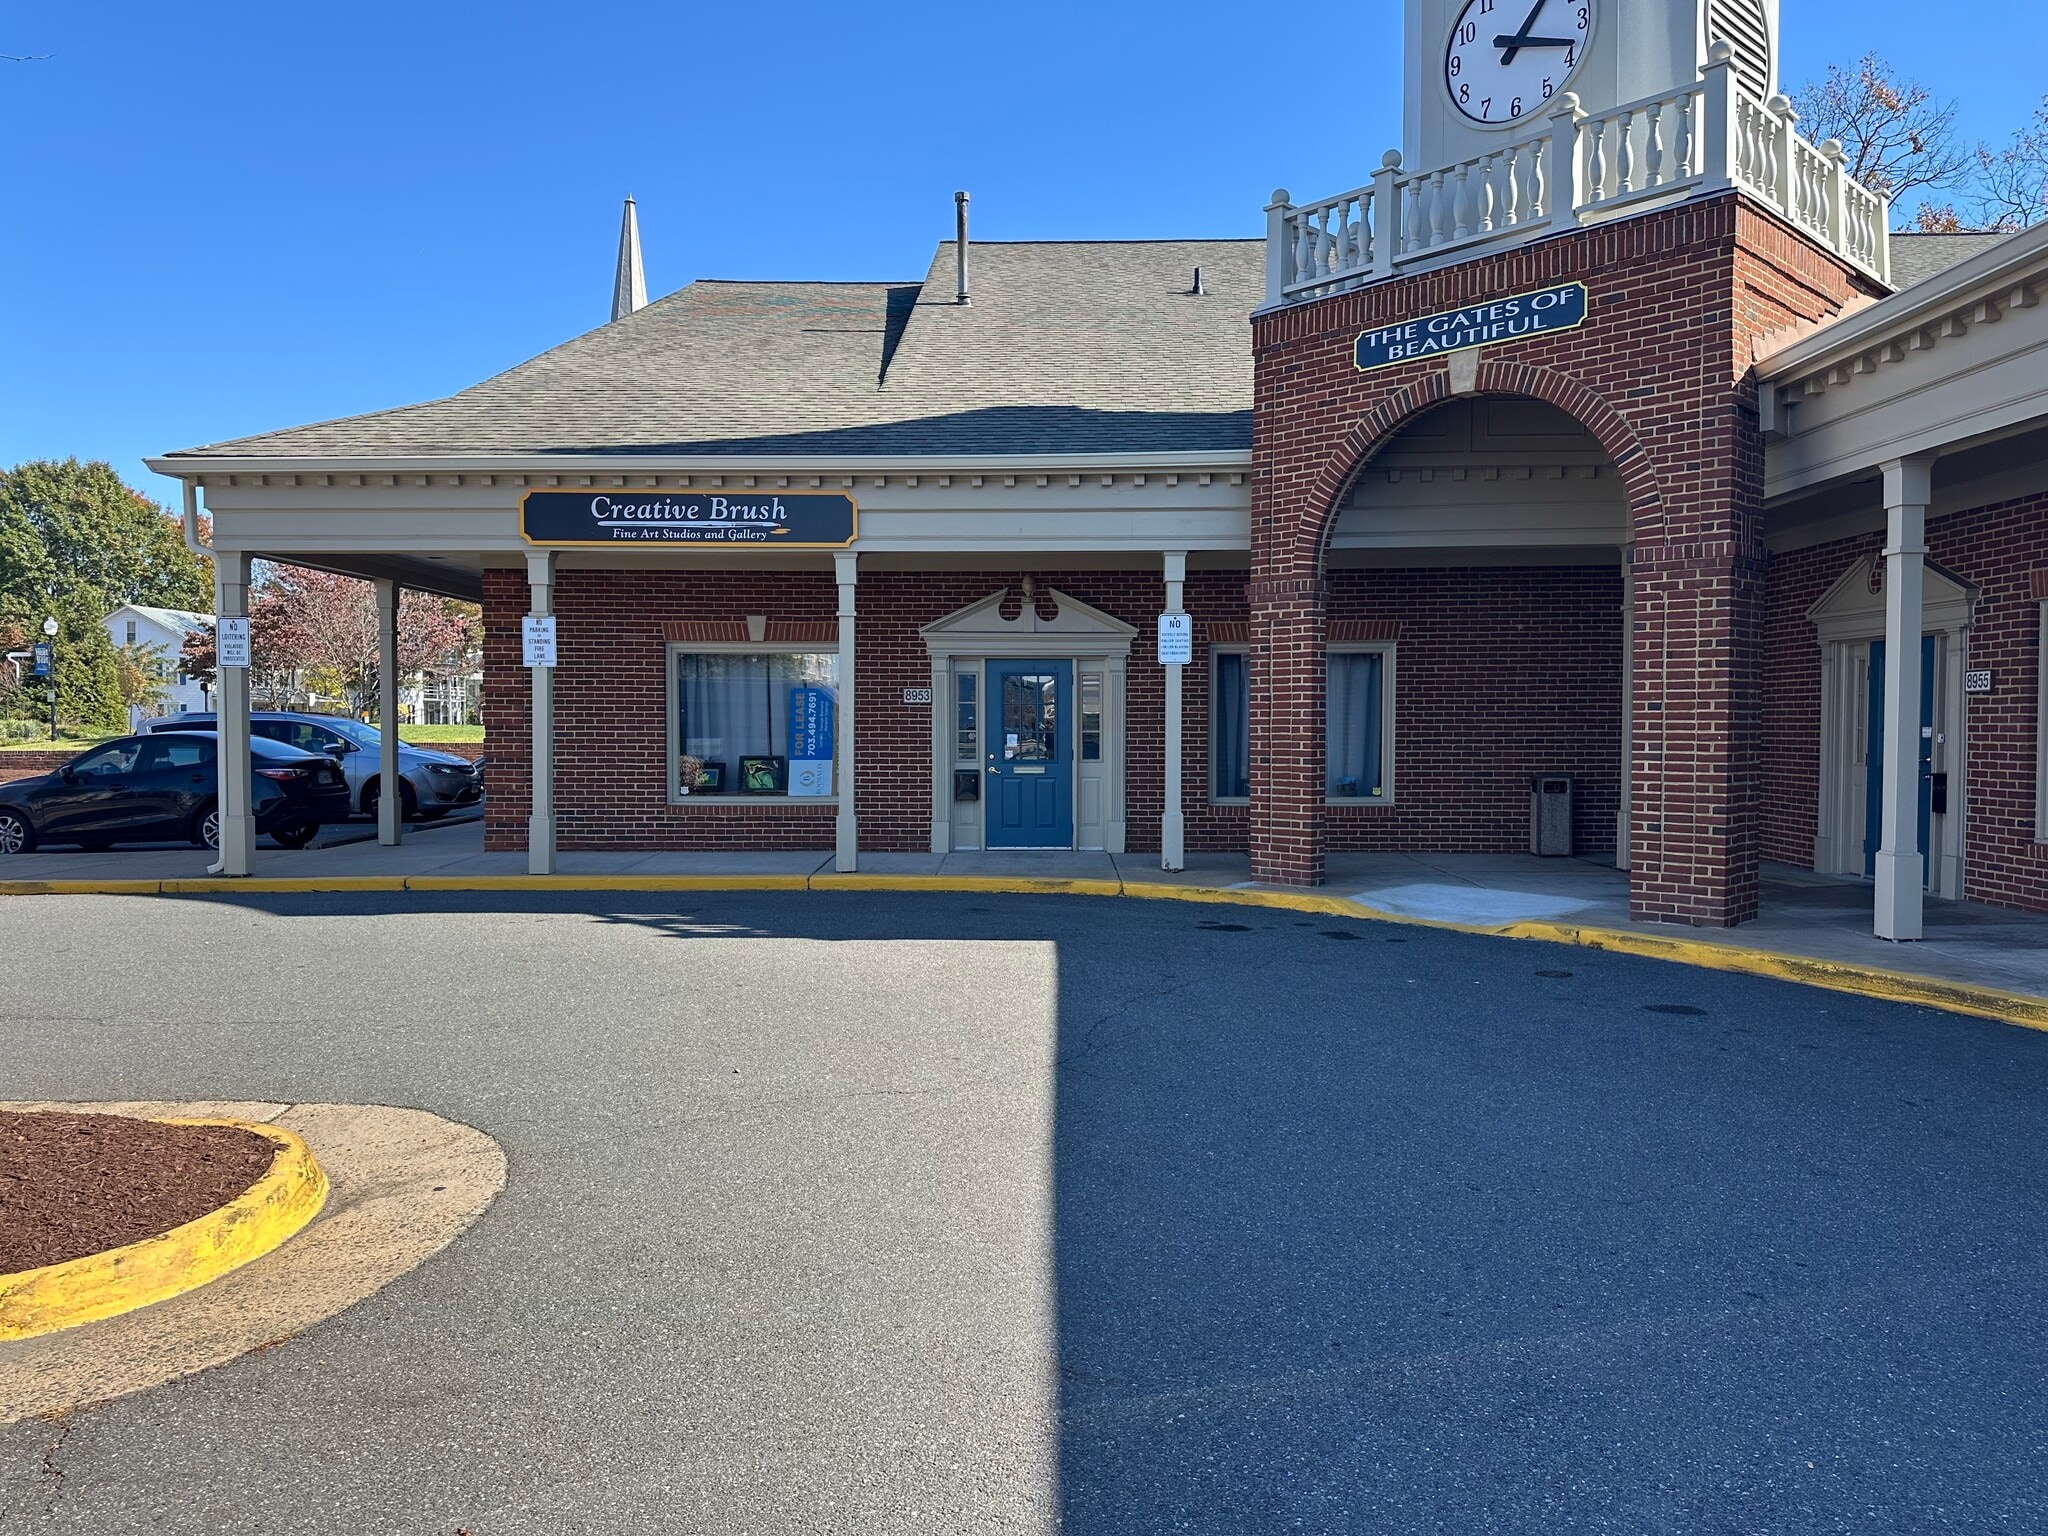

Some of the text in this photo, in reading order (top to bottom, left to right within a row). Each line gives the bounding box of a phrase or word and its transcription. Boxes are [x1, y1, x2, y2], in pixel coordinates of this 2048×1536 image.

[1577, 8, 1588, 30] 3
[1459, 22, 1476, 47] 10
[1450, 56, 1461, 77] 9
[1563, 46, 1575, 69] 4
[1459, 83, 1470, 104] 8
[1542, 77, 1553, 99] 5
[1481, 97, 1492, 119] 7
[1510, 97, 1522, 118] 6
[1365, 288, 1575, 347] THE GATES OF
[1388, 314, 1548, 361] BEAUTIFUL
[590, 496, 788, 521] Creative Brush
[612, 528, 768, 542] Fine Art Studios and Gallery
[229, 623, 238, 631] NO
[1169, 619, 1181, 629] NO
[221, 633, 246, 641] LOITERING
[1966, 672, 1989, 689] 8955
[905, 689, 930, 701] 8953
[794, 692, 806, 756] FOR LEASE
[807, 692, 817, 756] 703.494.7691
